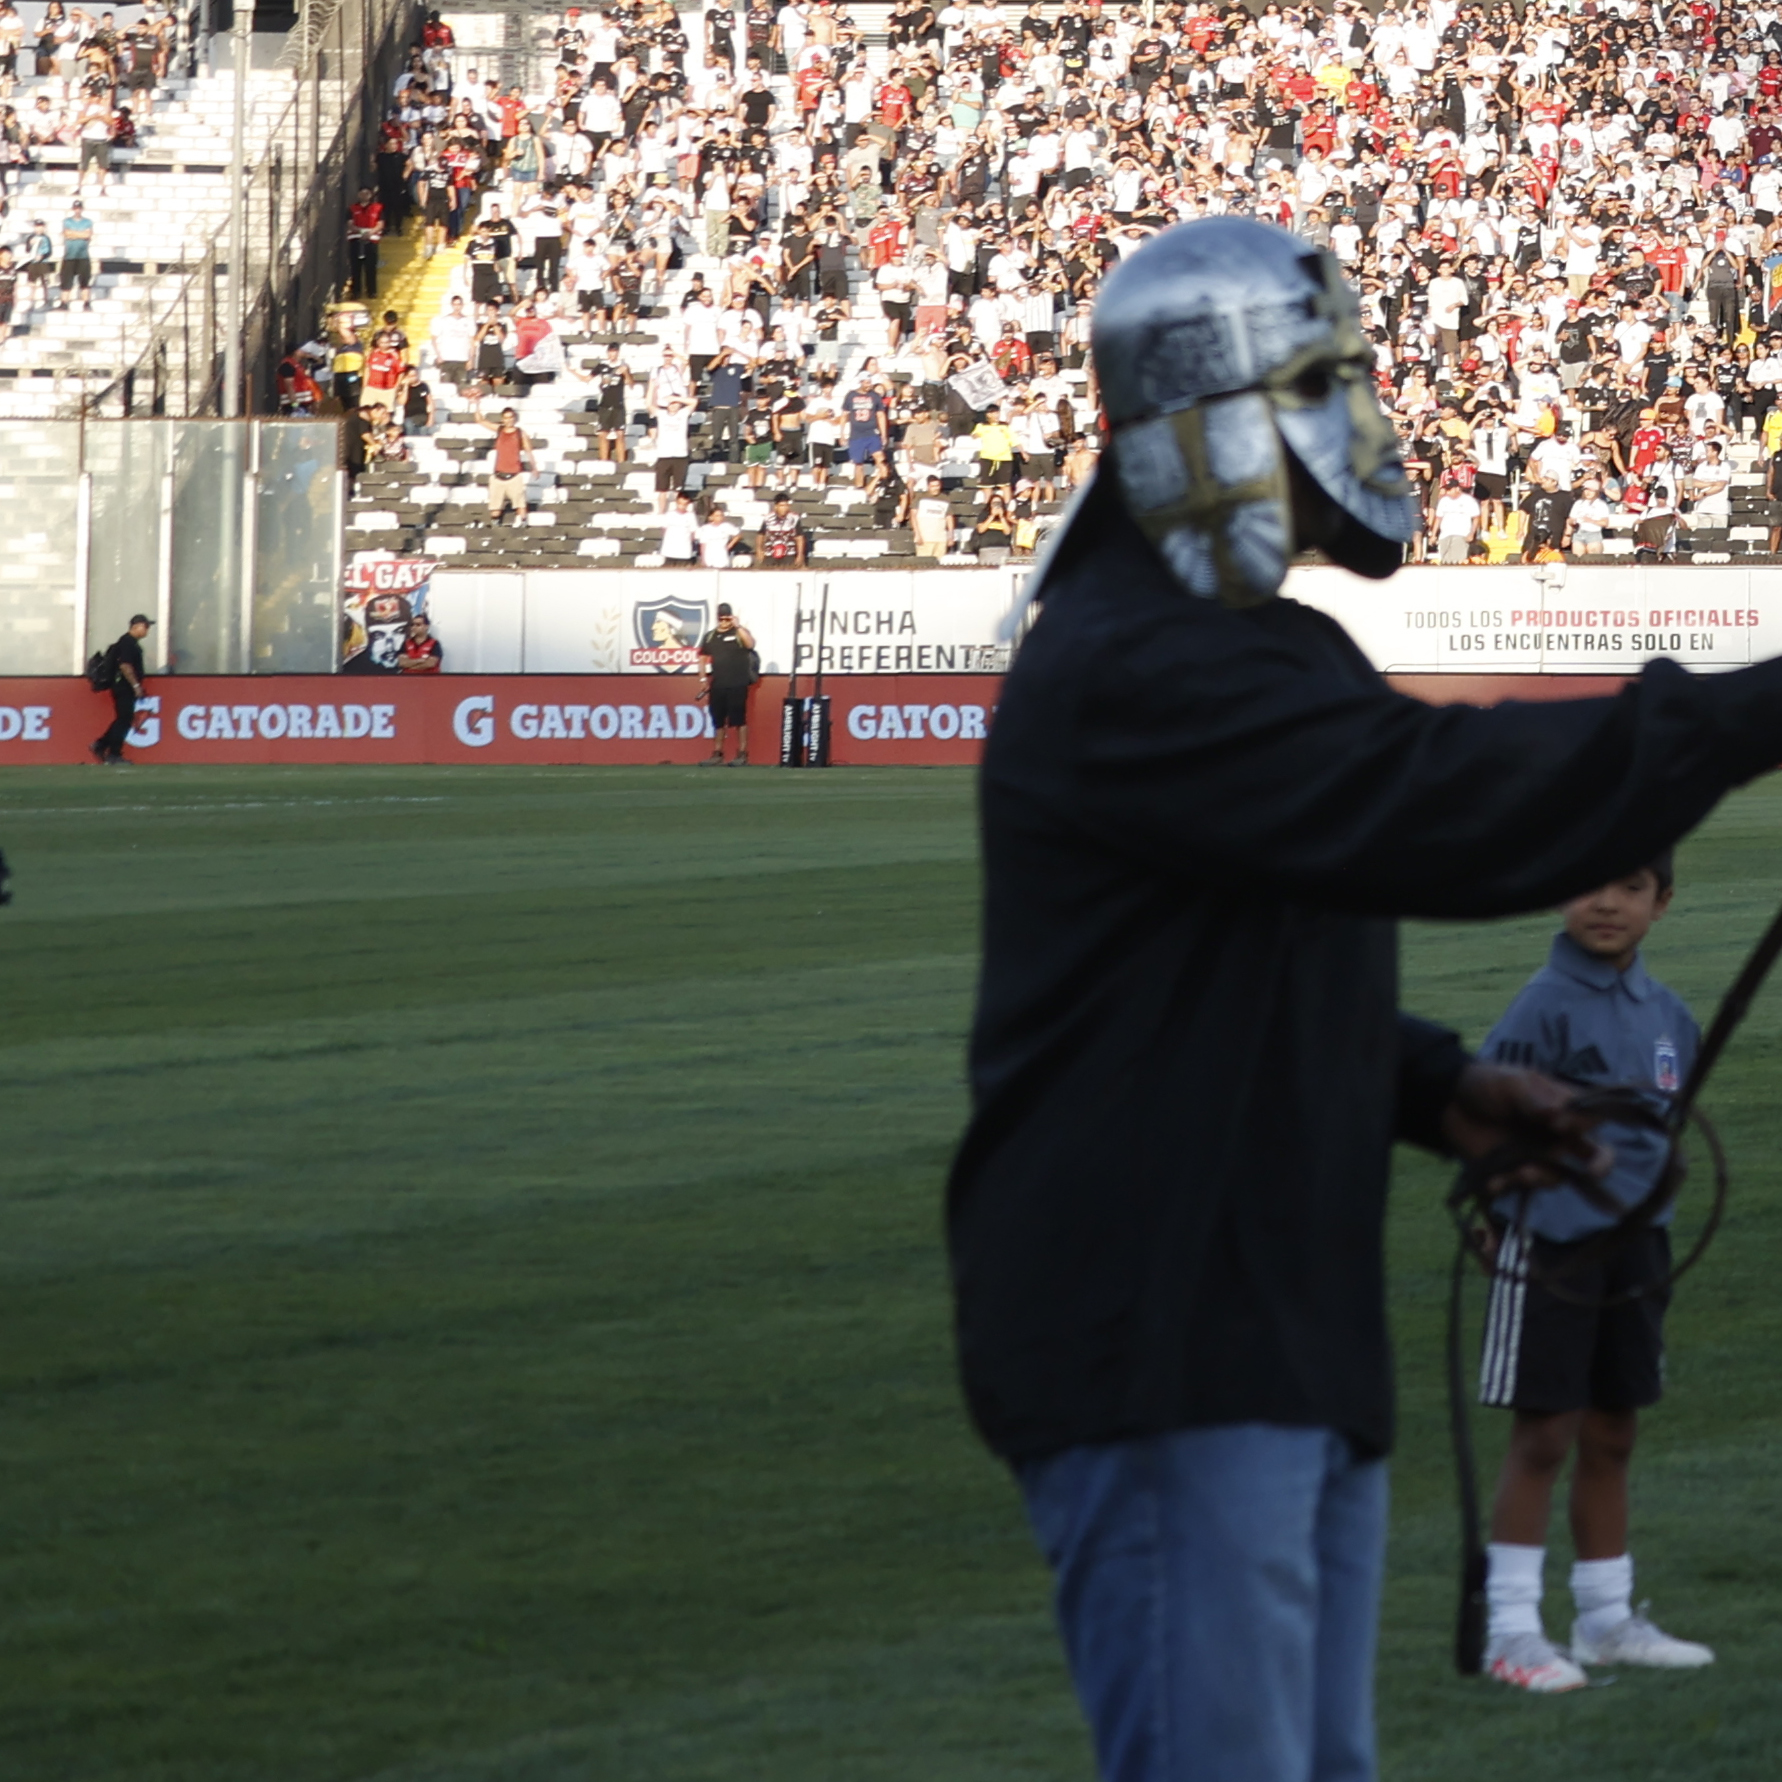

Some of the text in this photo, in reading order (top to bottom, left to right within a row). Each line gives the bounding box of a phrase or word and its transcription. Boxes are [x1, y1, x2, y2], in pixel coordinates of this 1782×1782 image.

[1404, 609, 1760, 629] TODOS LOS PRODUCTOS OFICIALES
[1449, 633, 1714, 651] LOS ENCUENTRAS SOLO EN
[632, 649, 700, 664] COLO-COL
[176, 704, 396, 740] GATORADE
